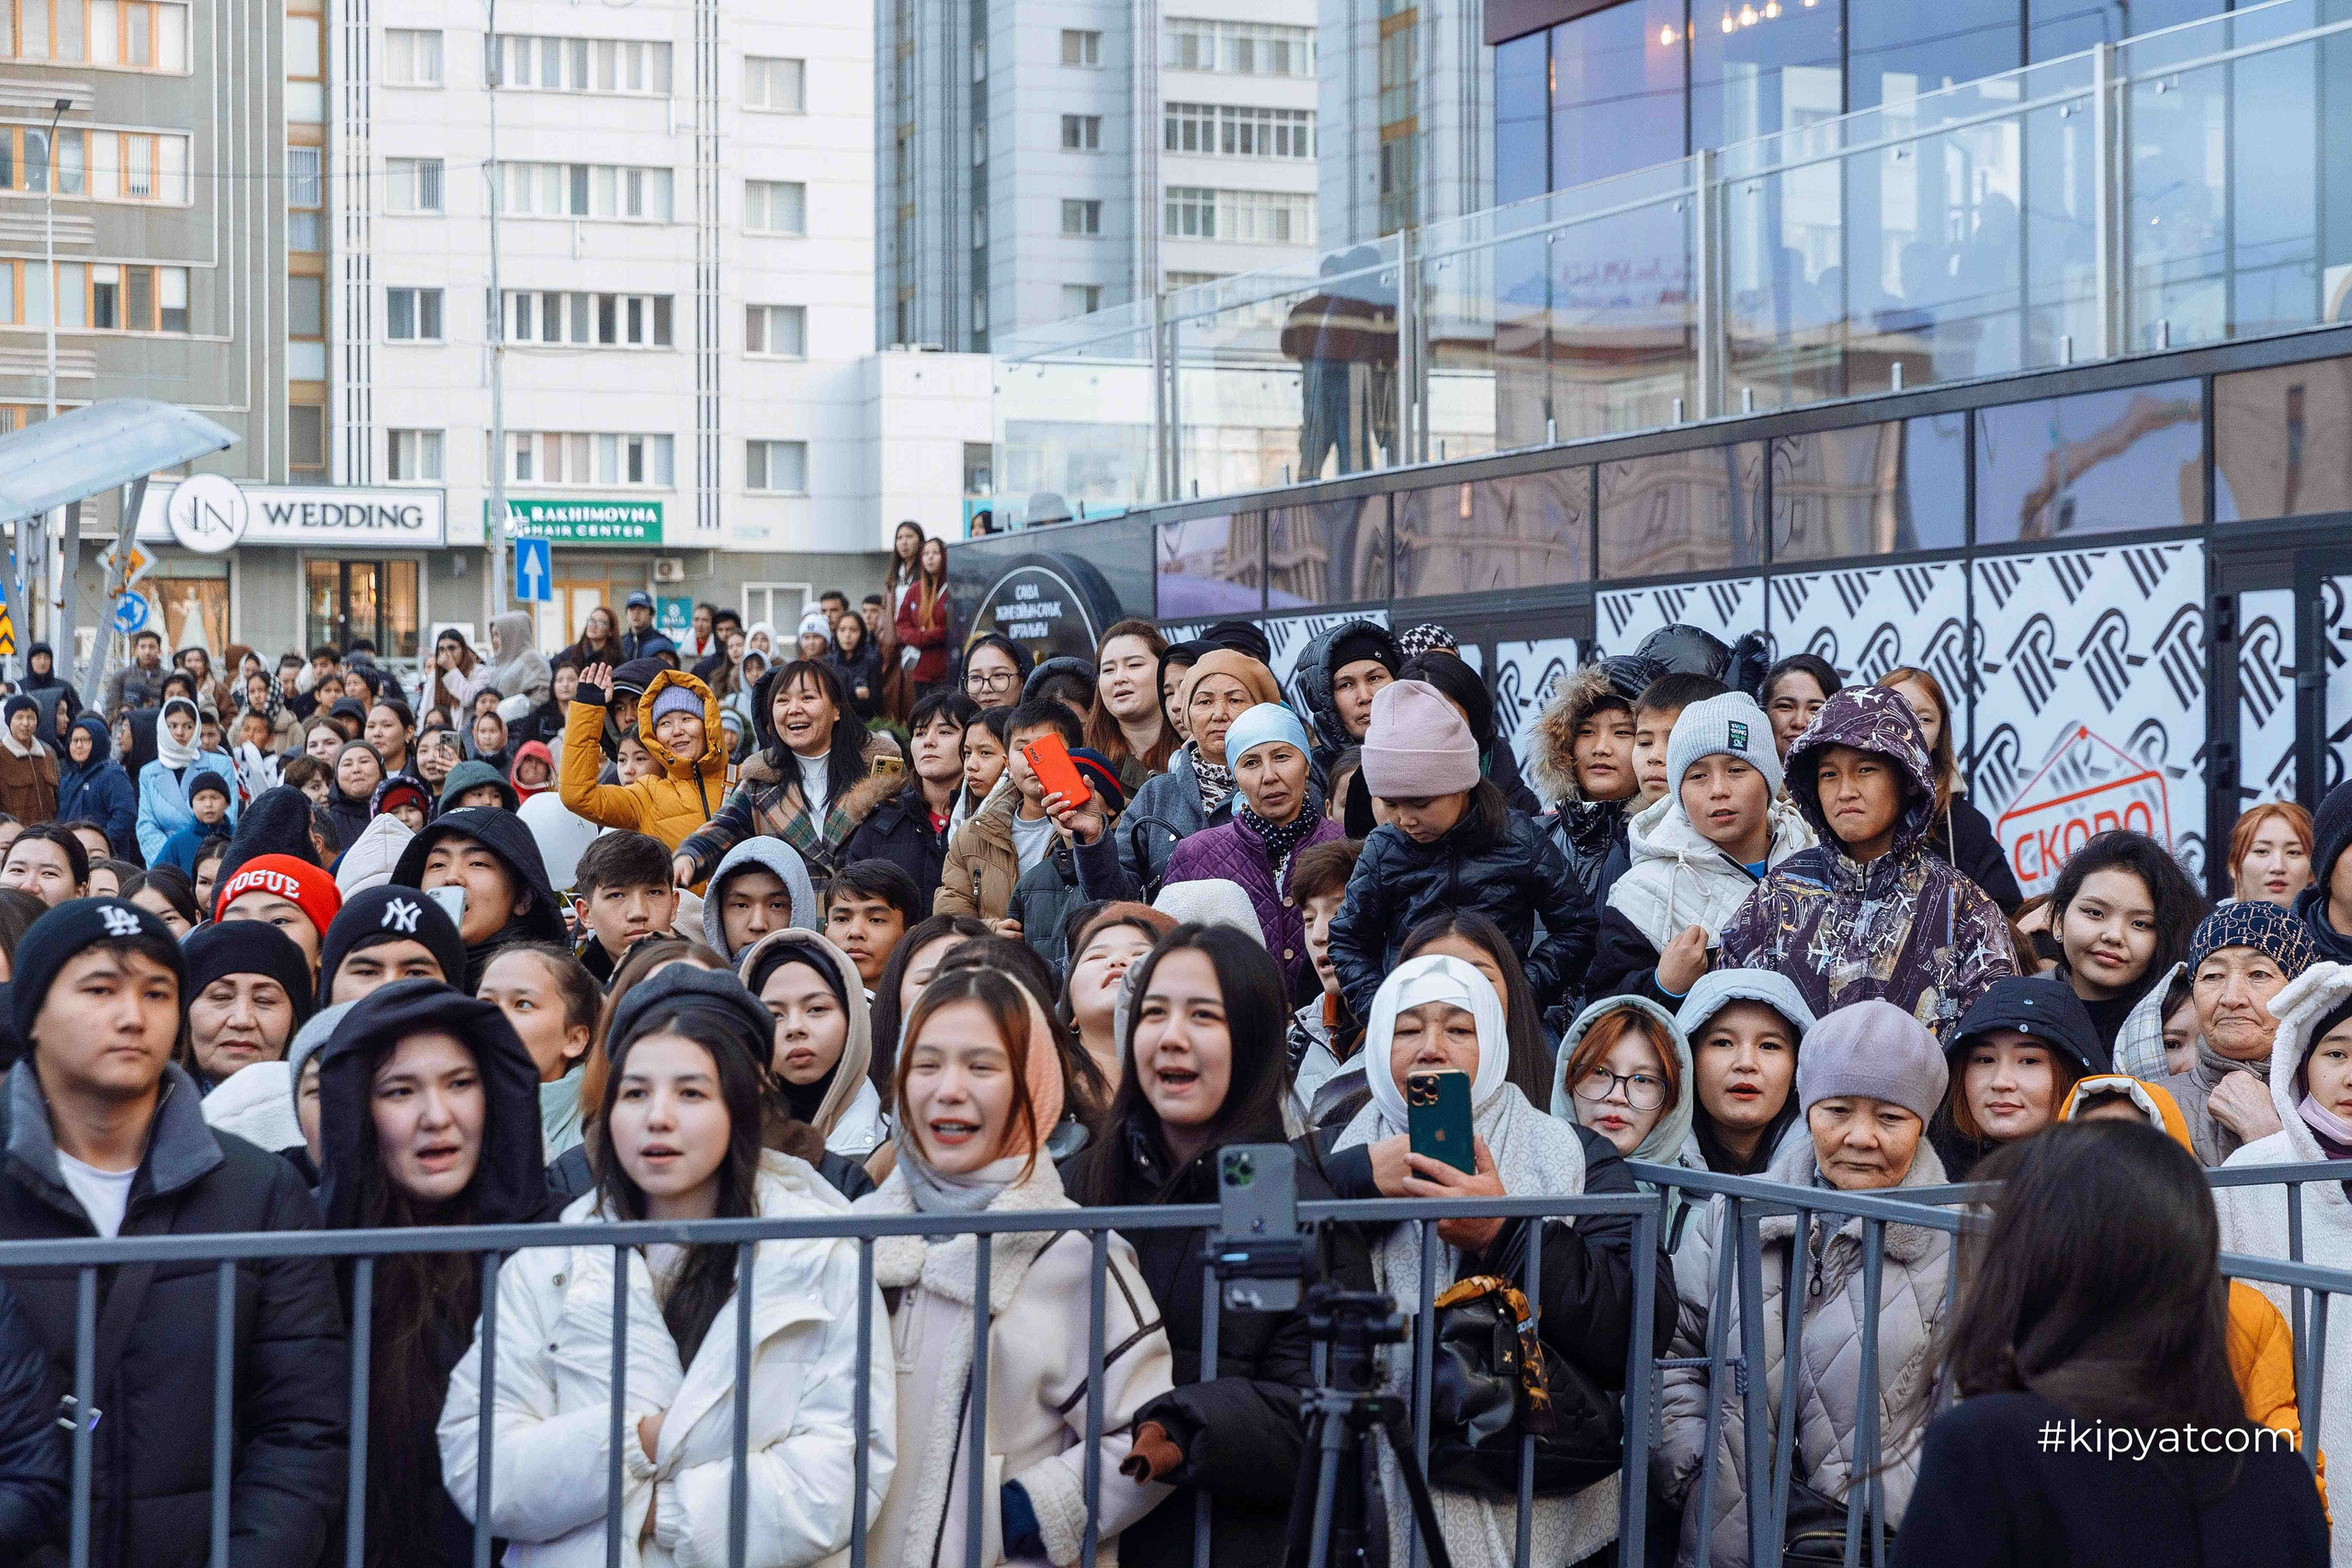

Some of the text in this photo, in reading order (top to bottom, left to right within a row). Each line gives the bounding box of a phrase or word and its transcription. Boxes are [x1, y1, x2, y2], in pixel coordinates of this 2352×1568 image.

[261, 502, 424, 529] WEDDING
[530, 505, 658, 523] RAKHIMOVNA
[530, 525, 645, 538] HAIR CENTER
[96, 905, 142, 936] LA
[380, 897, 423, 933] NY
